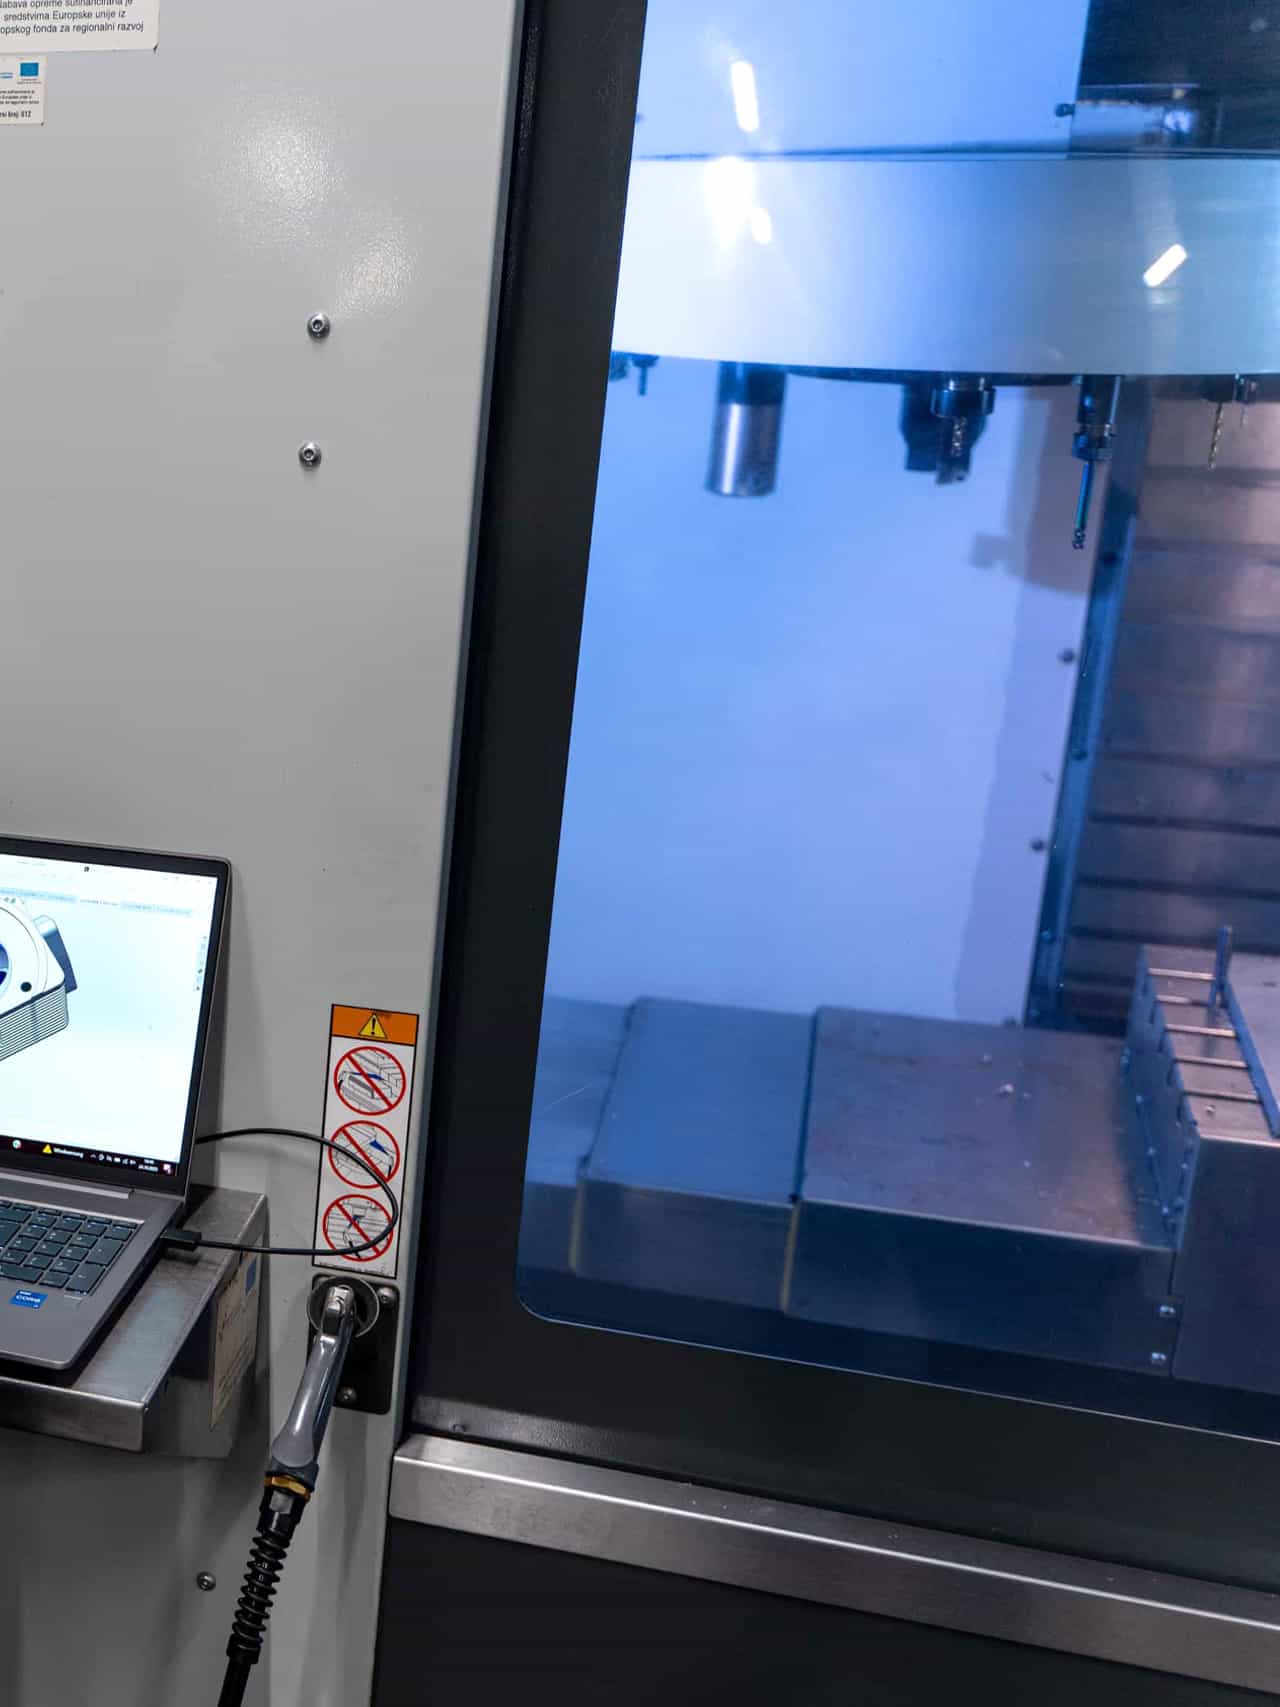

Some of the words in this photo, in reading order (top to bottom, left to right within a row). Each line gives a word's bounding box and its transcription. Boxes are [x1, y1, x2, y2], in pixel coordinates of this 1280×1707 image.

[3, 12, 50, 21] sredstvima
[52, 11, 92, 21] Europske
[96, 11, 116, 20] unije
[118, 10, 126, 18] iz
[33, 24, 57, 33] fonda
[73, 22, 115, 35] regionalni
[117, 22, 144, 33] razvoj
